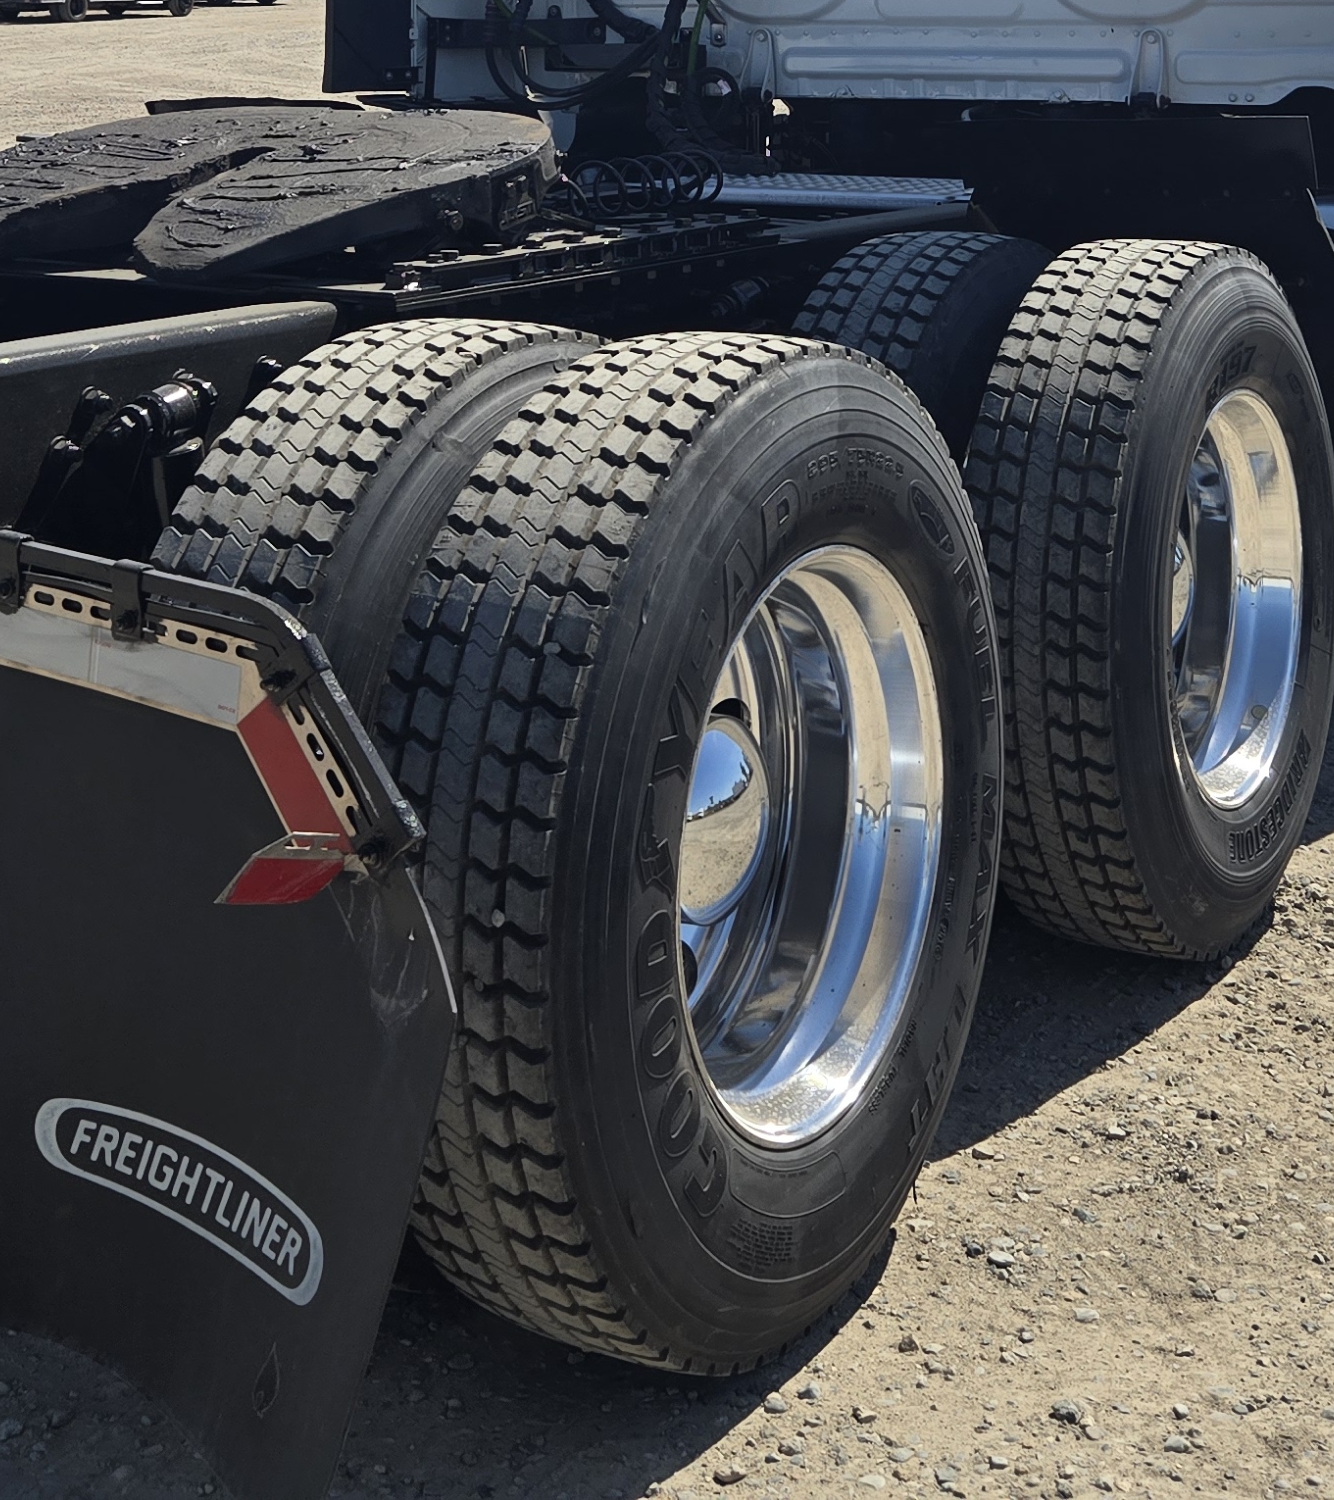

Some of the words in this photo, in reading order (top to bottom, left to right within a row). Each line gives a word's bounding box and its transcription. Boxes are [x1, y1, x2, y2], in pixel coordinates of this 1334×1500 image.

[966, 772, 998, 967] MAX
[1229, 728, 1312, 864] BRIDGESTONE
[69, 1118, 304, 1276] FREIGHTLINER
